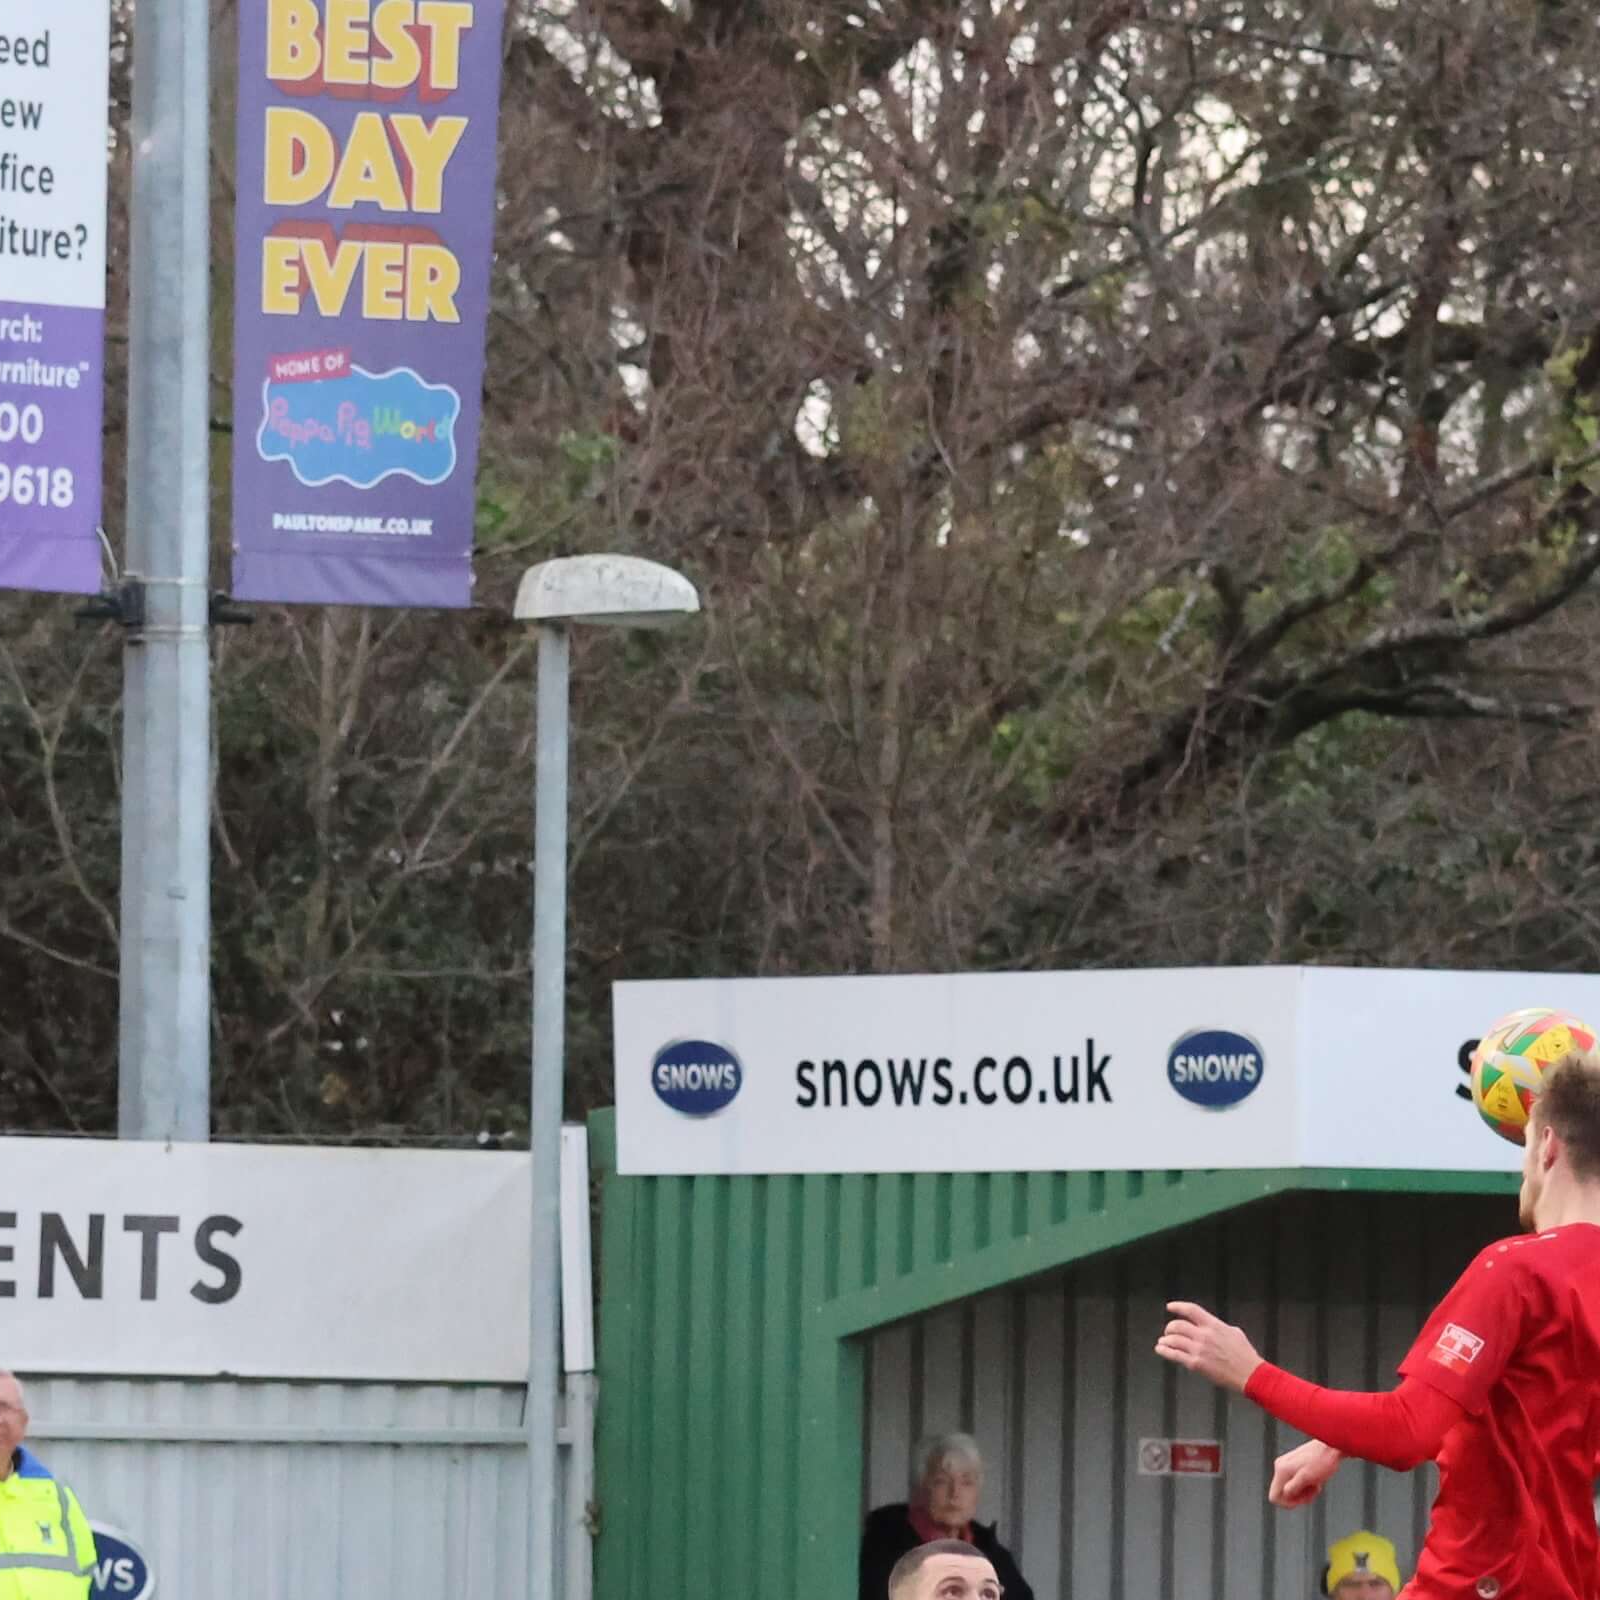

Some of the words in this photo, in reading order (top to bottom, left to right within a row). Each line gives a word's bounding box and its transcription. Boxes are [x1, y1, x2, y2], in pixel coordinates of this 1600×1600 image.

[266, 0, 474, 91] BEST
[264, 106, 469, 214] DAY
[261, 235, 461, 324] EVER
[275, 357, 321, 378] HOME
[324, 354, 345, 371] OF
[656, 1062, 737, 1092] SNOWS
[795, 1038, 1114, 1108] snows.co.uk
[1171, 1053, 1260, 1084] SNOWS
